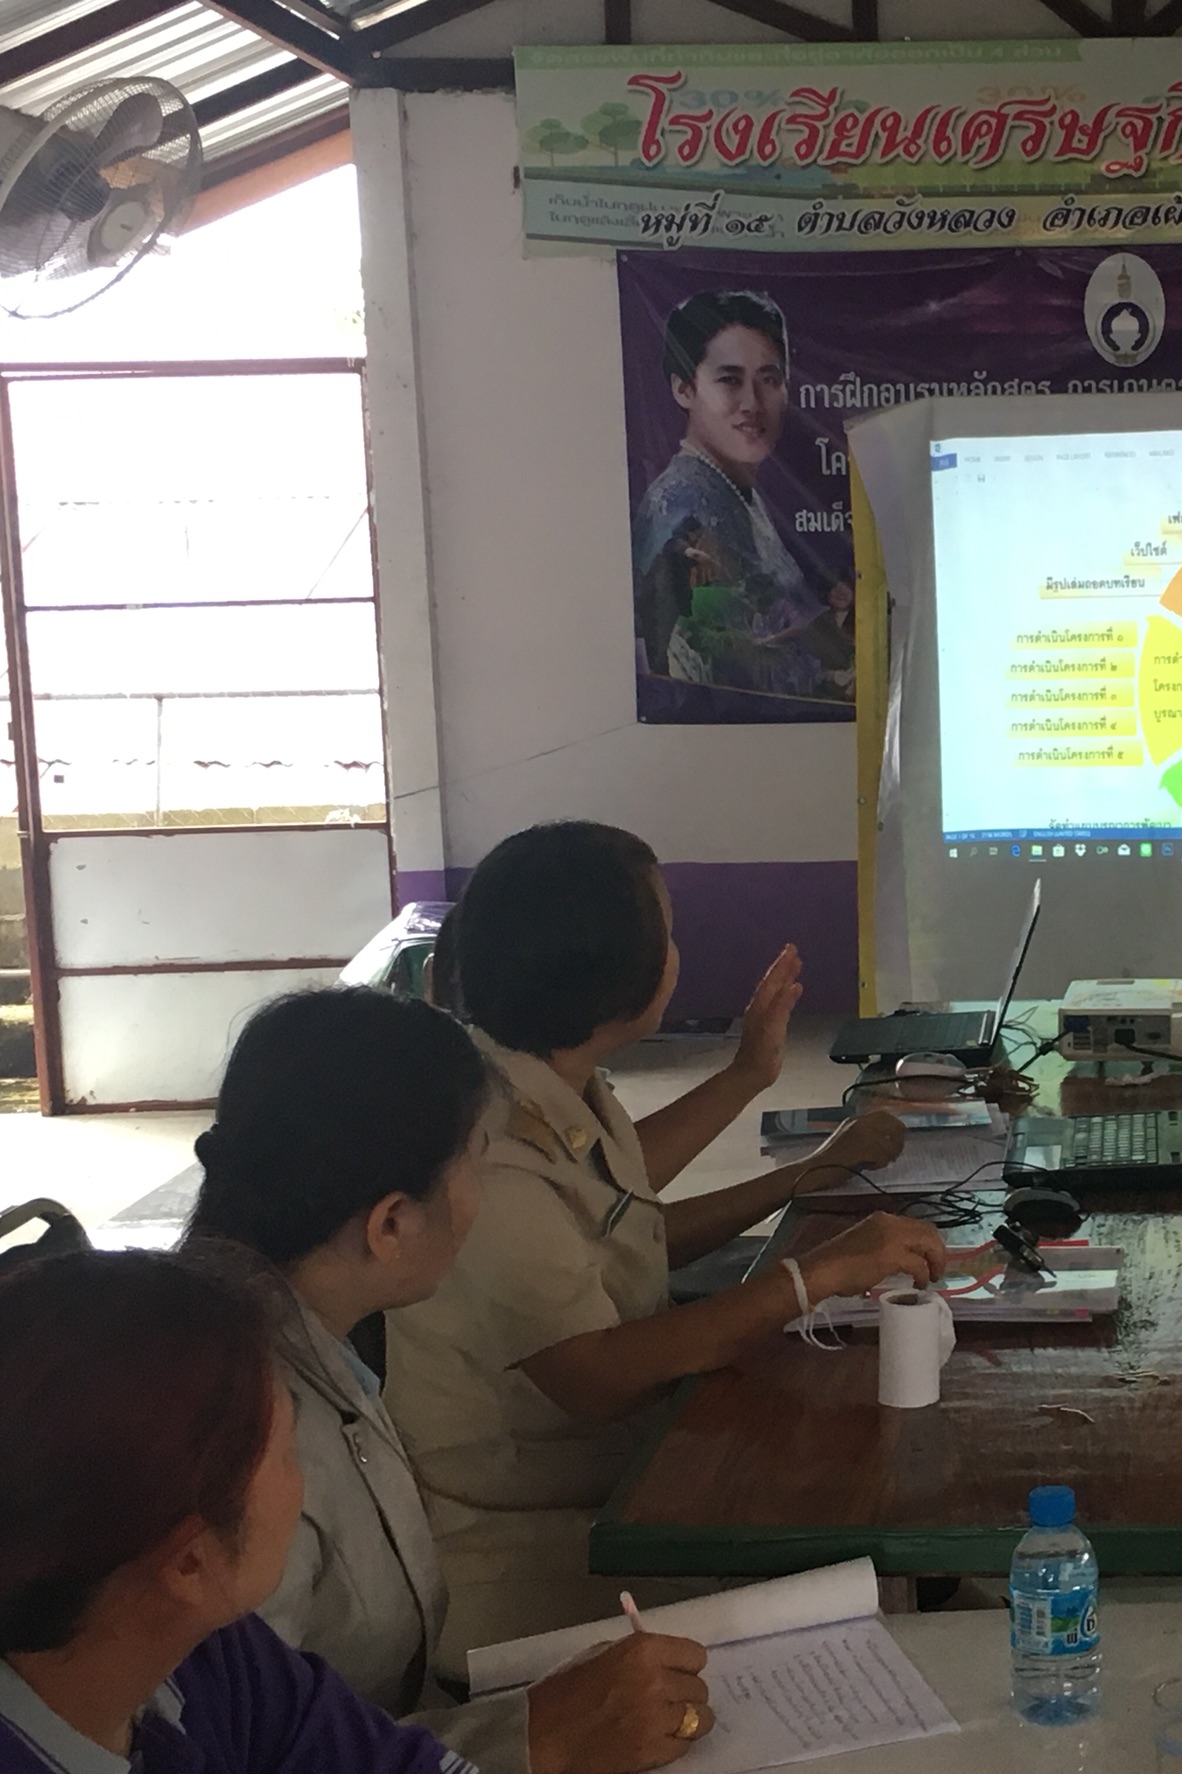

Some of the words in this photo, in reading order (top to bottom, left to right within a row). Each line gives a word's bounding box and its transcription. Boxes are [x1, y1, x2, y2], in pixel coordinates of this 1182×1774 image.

[640, 192, 722, 249] หมู่ที่
[725, 213, 777, 236] ๑๕
[796, 195, 1016, 235] ตำบลวังหลวง
